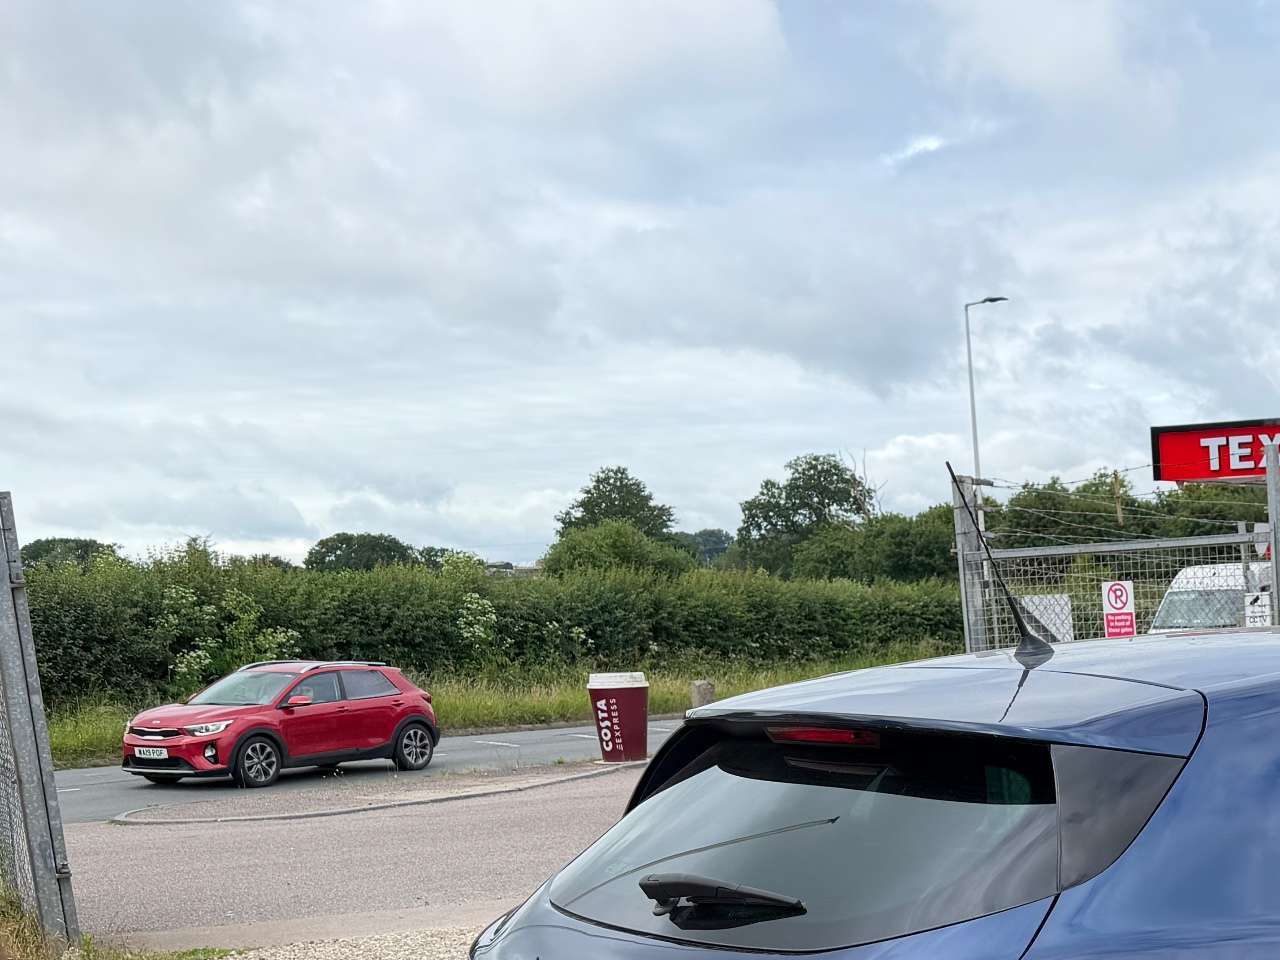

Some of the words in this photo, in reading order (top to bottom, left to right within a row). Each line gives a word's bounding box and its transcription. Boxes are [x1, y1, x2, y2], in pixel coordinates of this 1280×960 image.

[1249, 616, 1267, 625] CCTV
[597, 699, 612, 751] COSTA
[610, 698, 622, 743] EXPRESS
